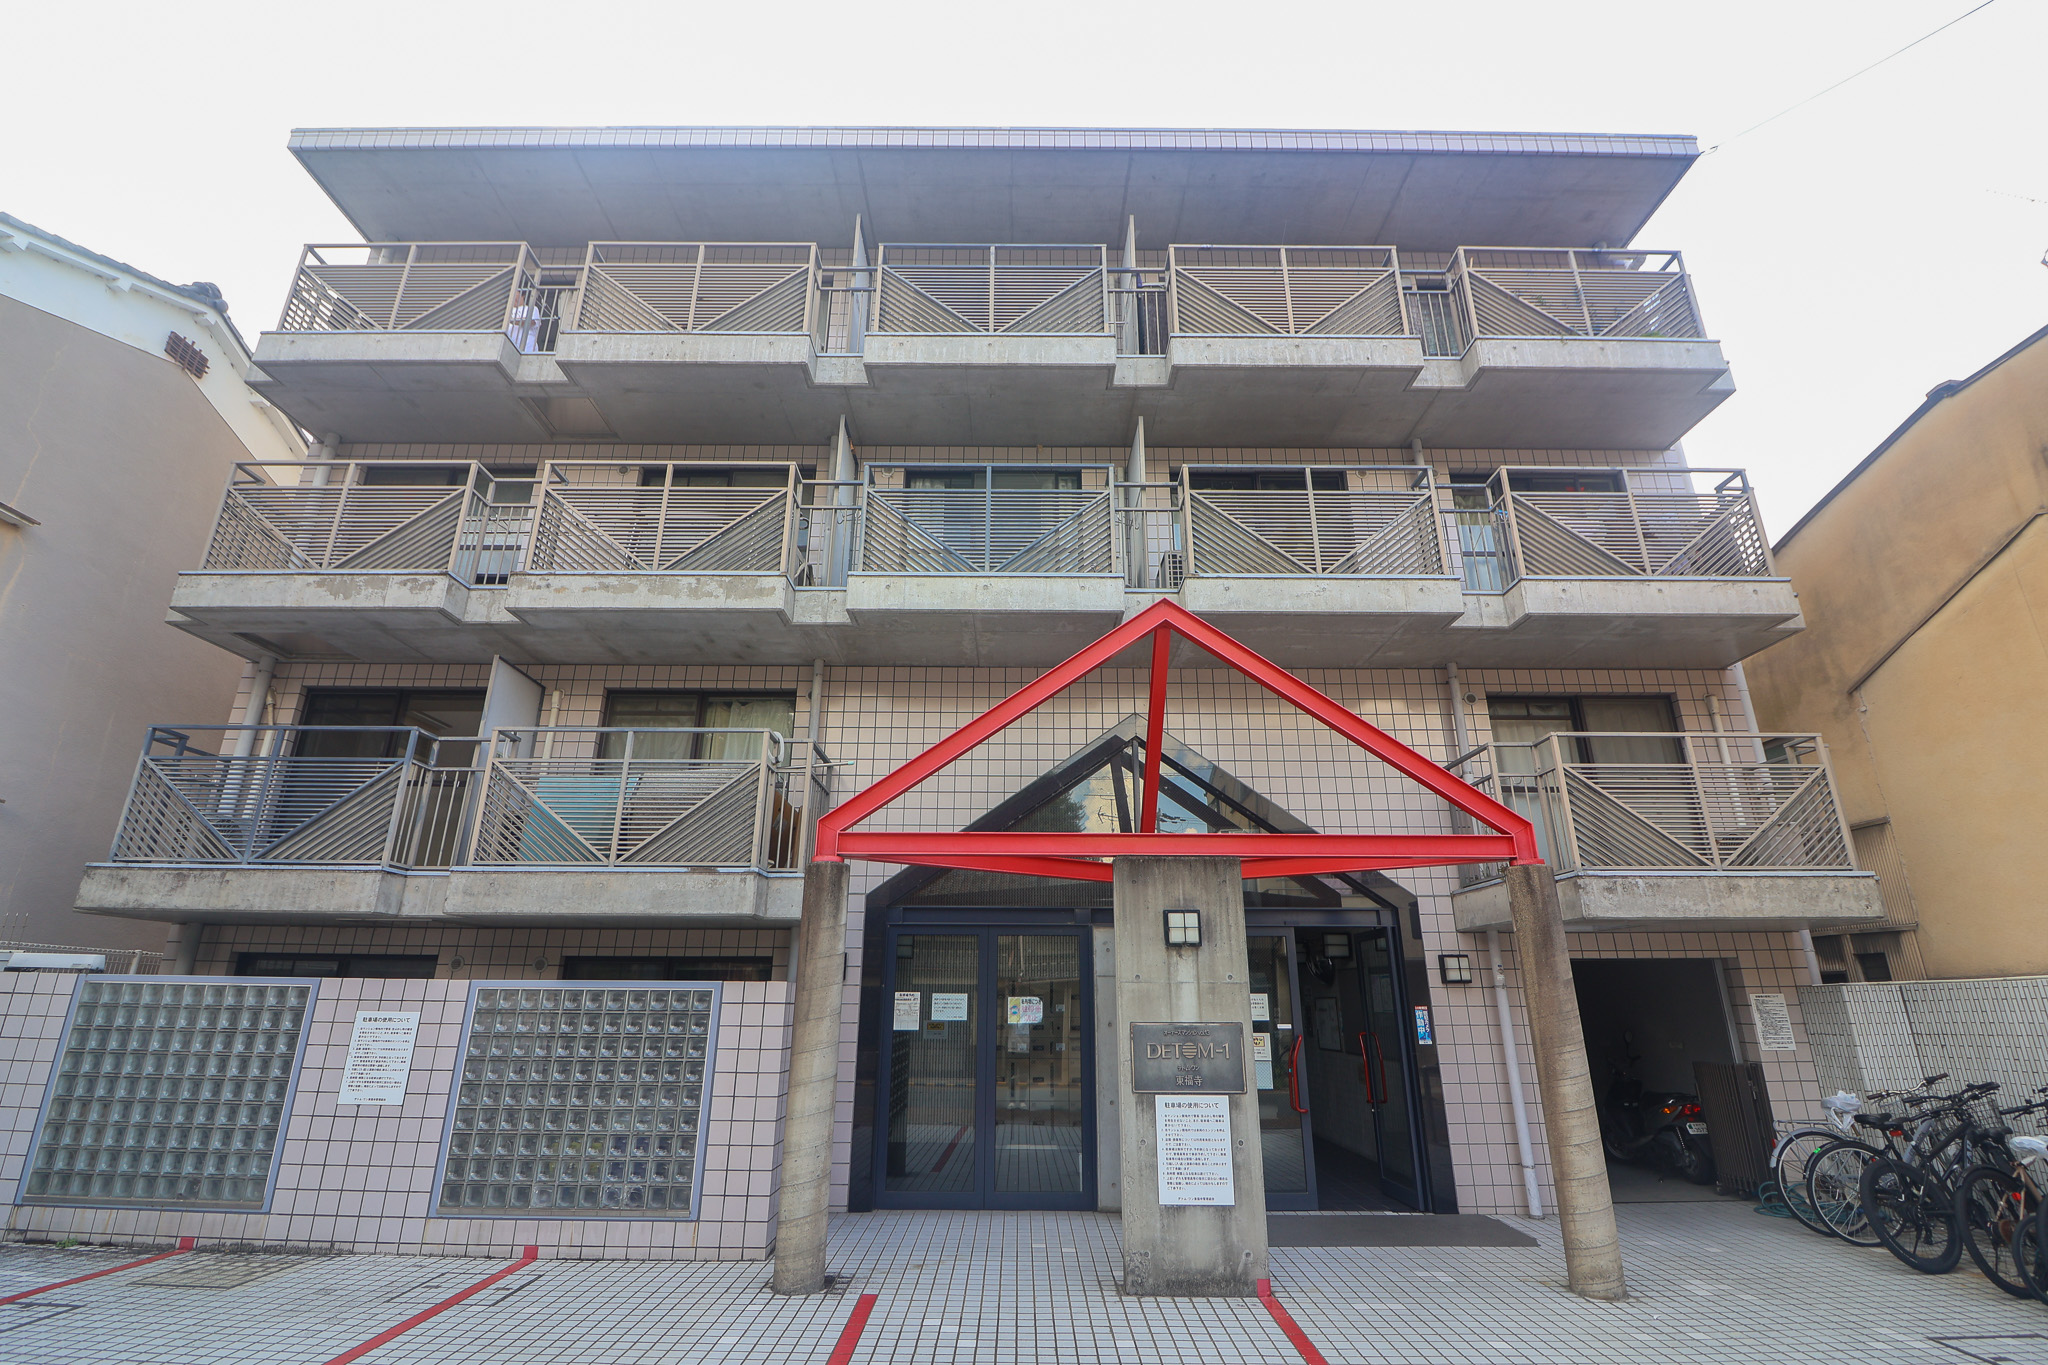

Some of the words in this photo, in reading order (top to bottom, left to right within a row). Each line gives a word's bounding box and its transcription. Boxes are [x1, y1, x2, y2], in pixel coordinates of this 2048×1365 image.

[1146, 1042, 1231, 1059] DETOM-1
[1175, 1074, 1203, 1087] 東福寺
[1164, 1101, 1220, 1109] 駐車場の使用について
